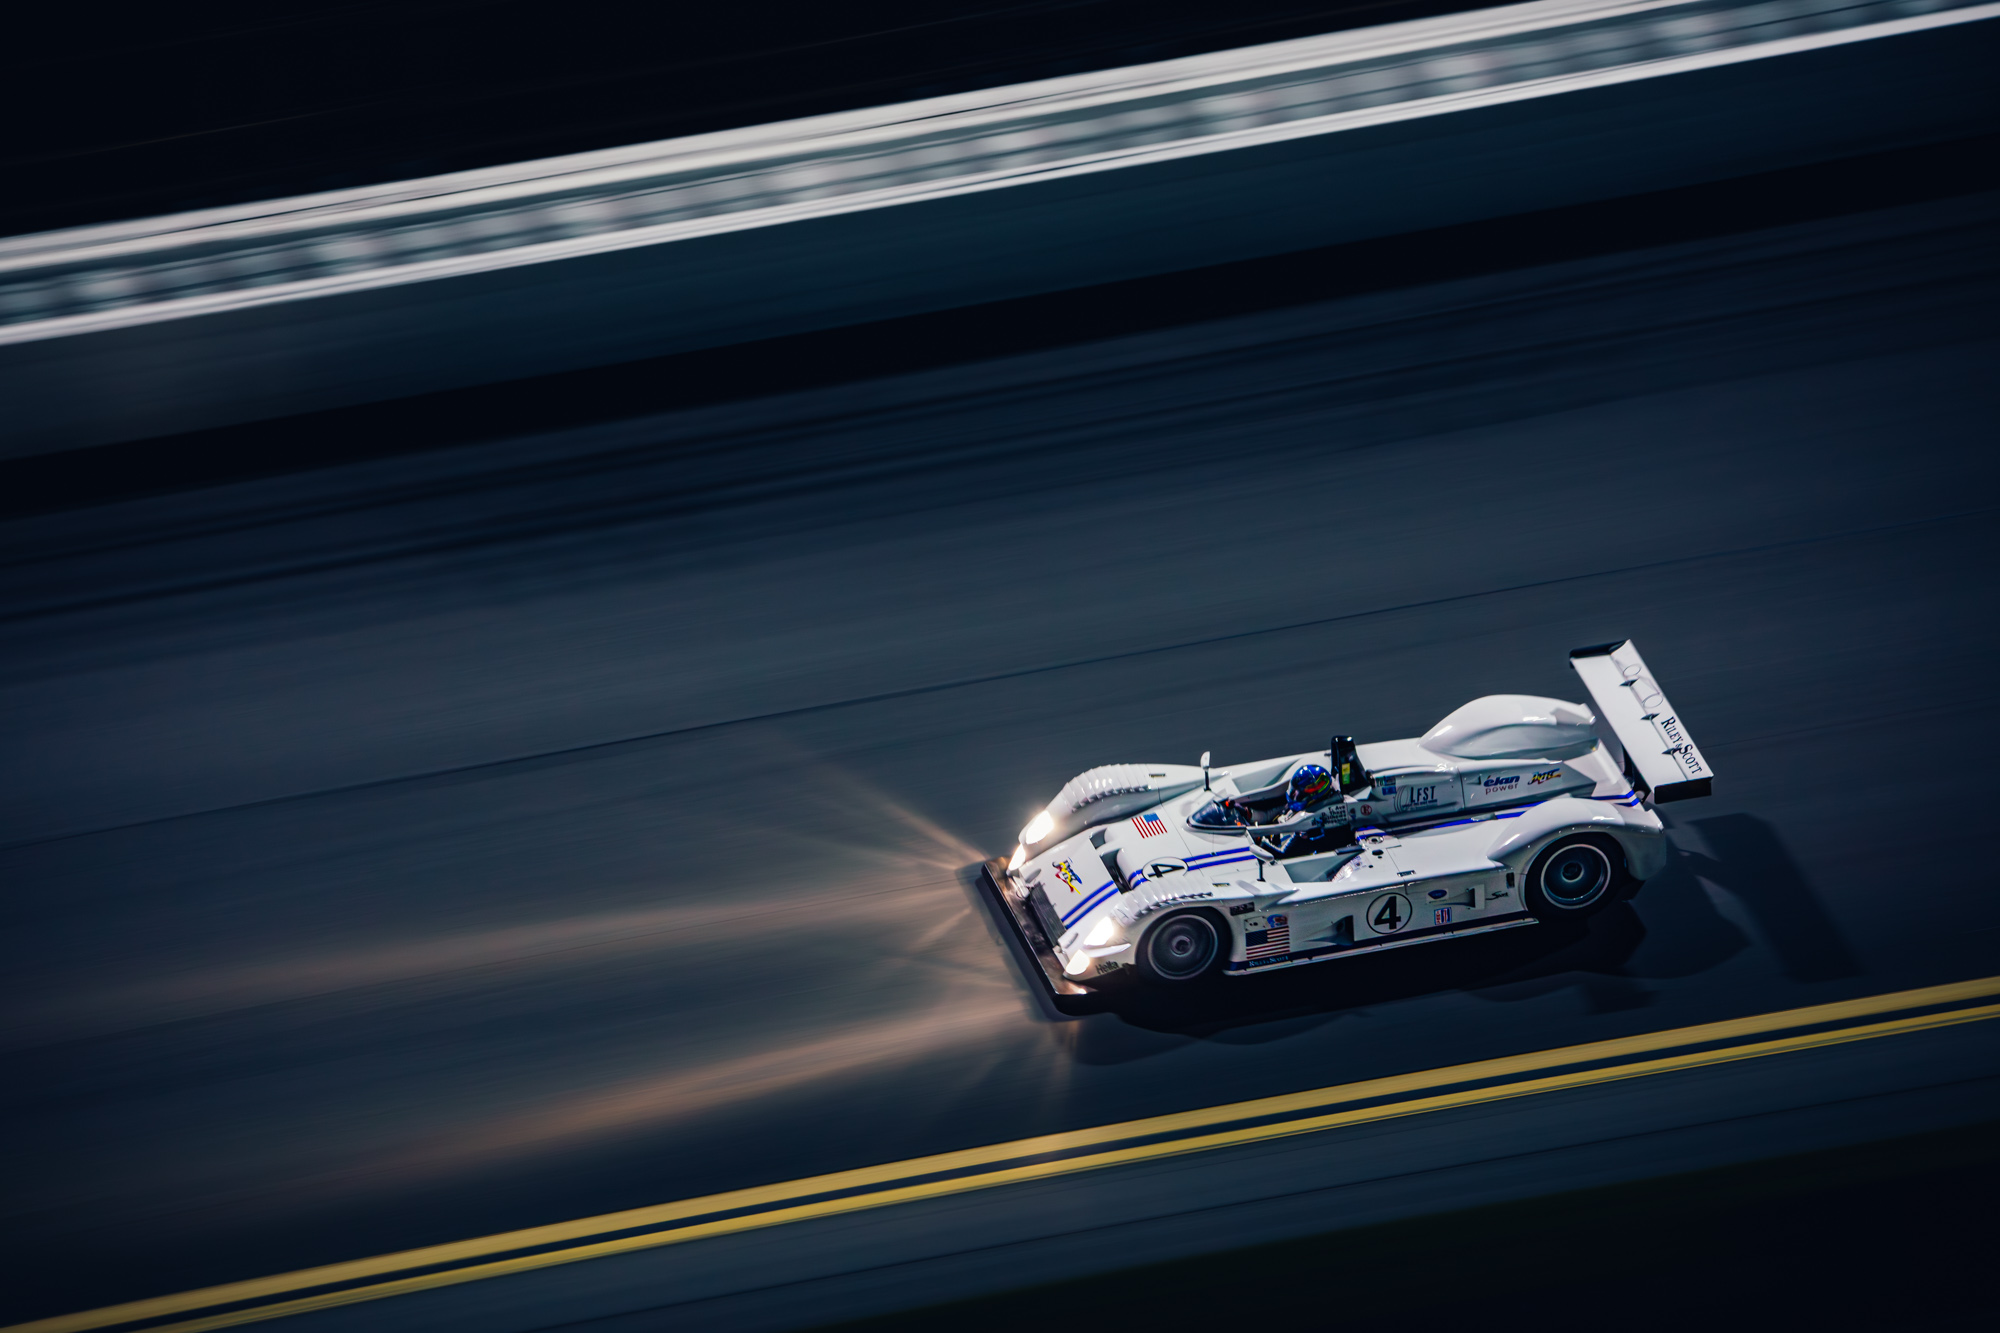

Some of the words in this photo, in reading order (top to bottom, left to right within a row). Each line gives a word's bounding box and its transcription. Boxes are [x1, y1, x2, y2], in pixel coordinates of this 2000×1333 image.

[1485, 783, 1518, 795] power
[1147, 863, 1185, 878] 4
[1374, 895, 1401, 930] 4
